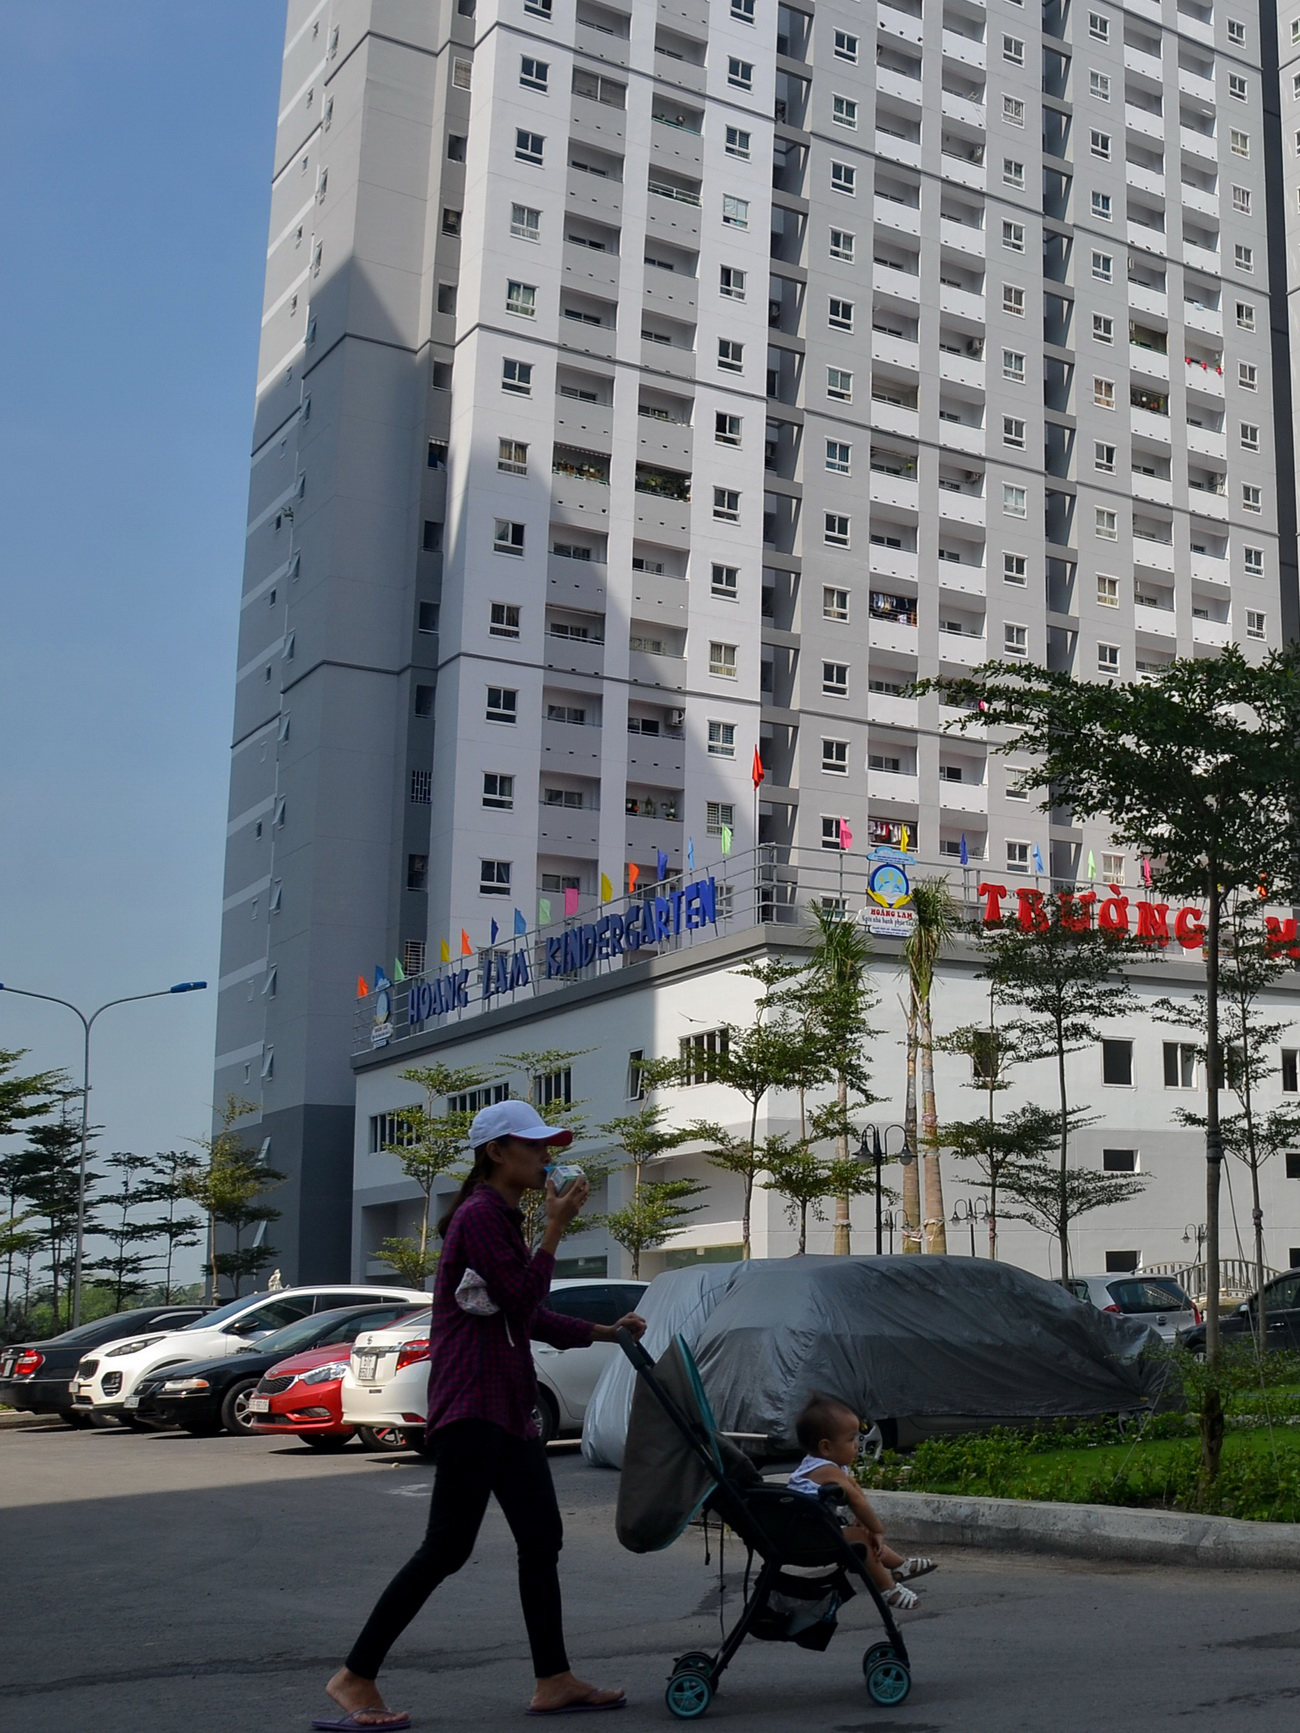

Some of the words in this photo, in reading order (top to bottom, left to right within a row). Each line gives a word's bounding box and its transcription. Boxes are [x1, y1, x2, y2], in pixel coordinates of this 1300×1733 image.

[482, 948, 530, 1000] LAM
[546, 876, 716, 979] KINDERGARTEN
[897, 911, 913, 919] LAM
